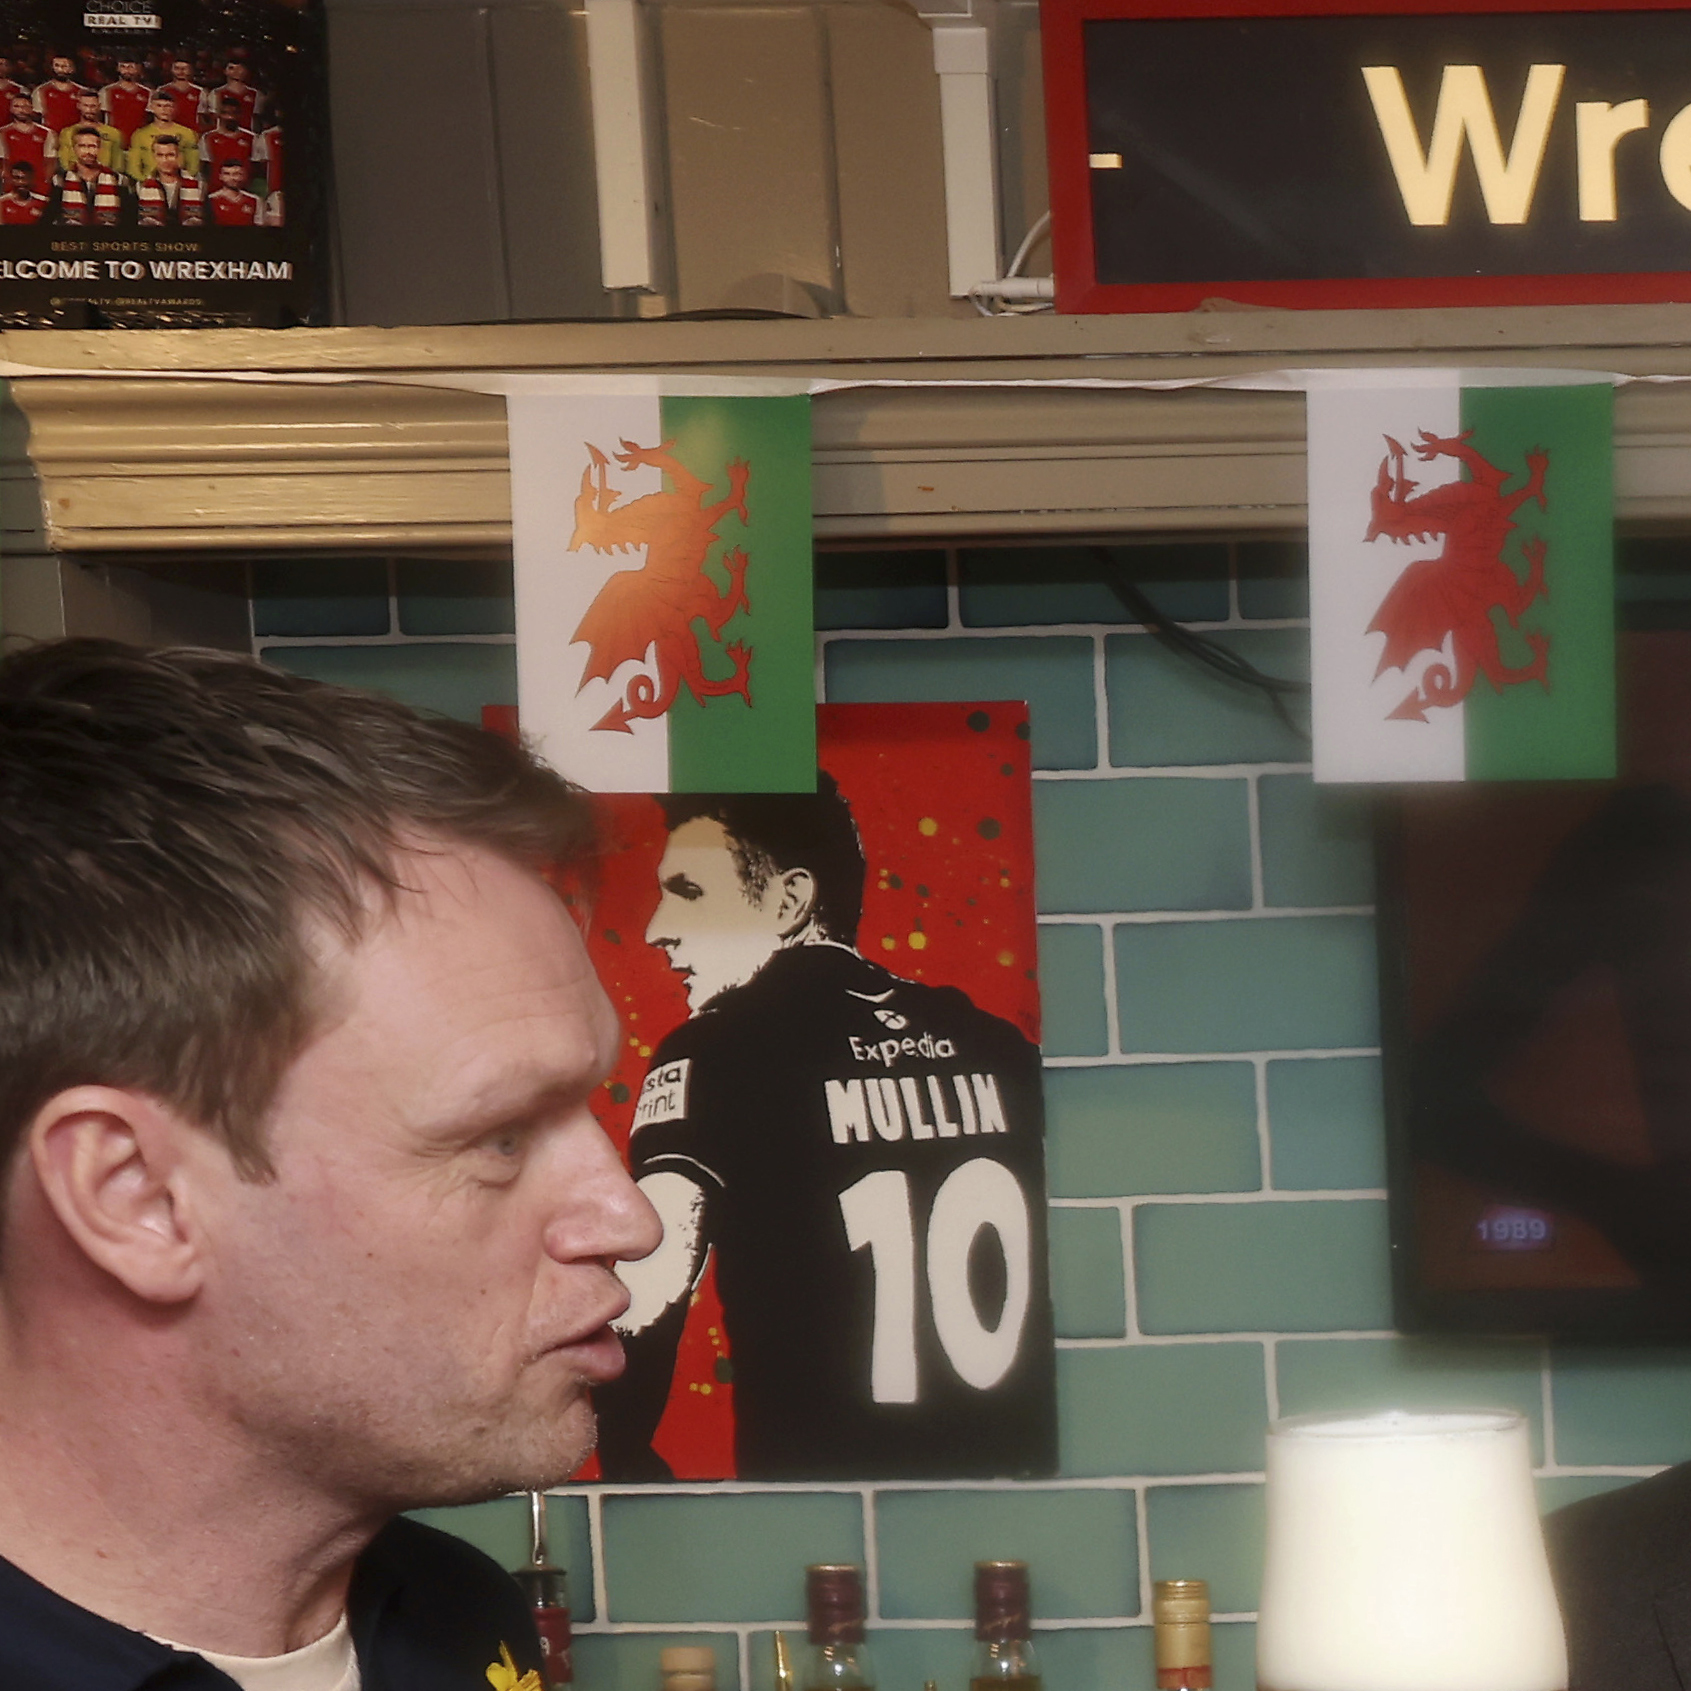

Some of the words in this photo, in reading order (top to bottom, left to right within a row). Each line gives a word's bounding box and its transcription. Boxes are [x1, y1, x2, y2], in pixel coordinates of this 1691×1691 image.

[87, 15, 126, 26] REAL
[51, 241, 85, 251] BEST
[92, 241, 149, 252] SPORTS
[154, 241, 199, 252] SHOW
[104, 260, 146, 280] TO
[149, 260, 293, 280] WREXHAM
[849, 1034, 956, 1067] Expedia
[825, 1072, 1008, 1145] MULLIN
[1477, 1218, 1547, 1240] 1989
[838, 1156, 1031, 1404] 10
